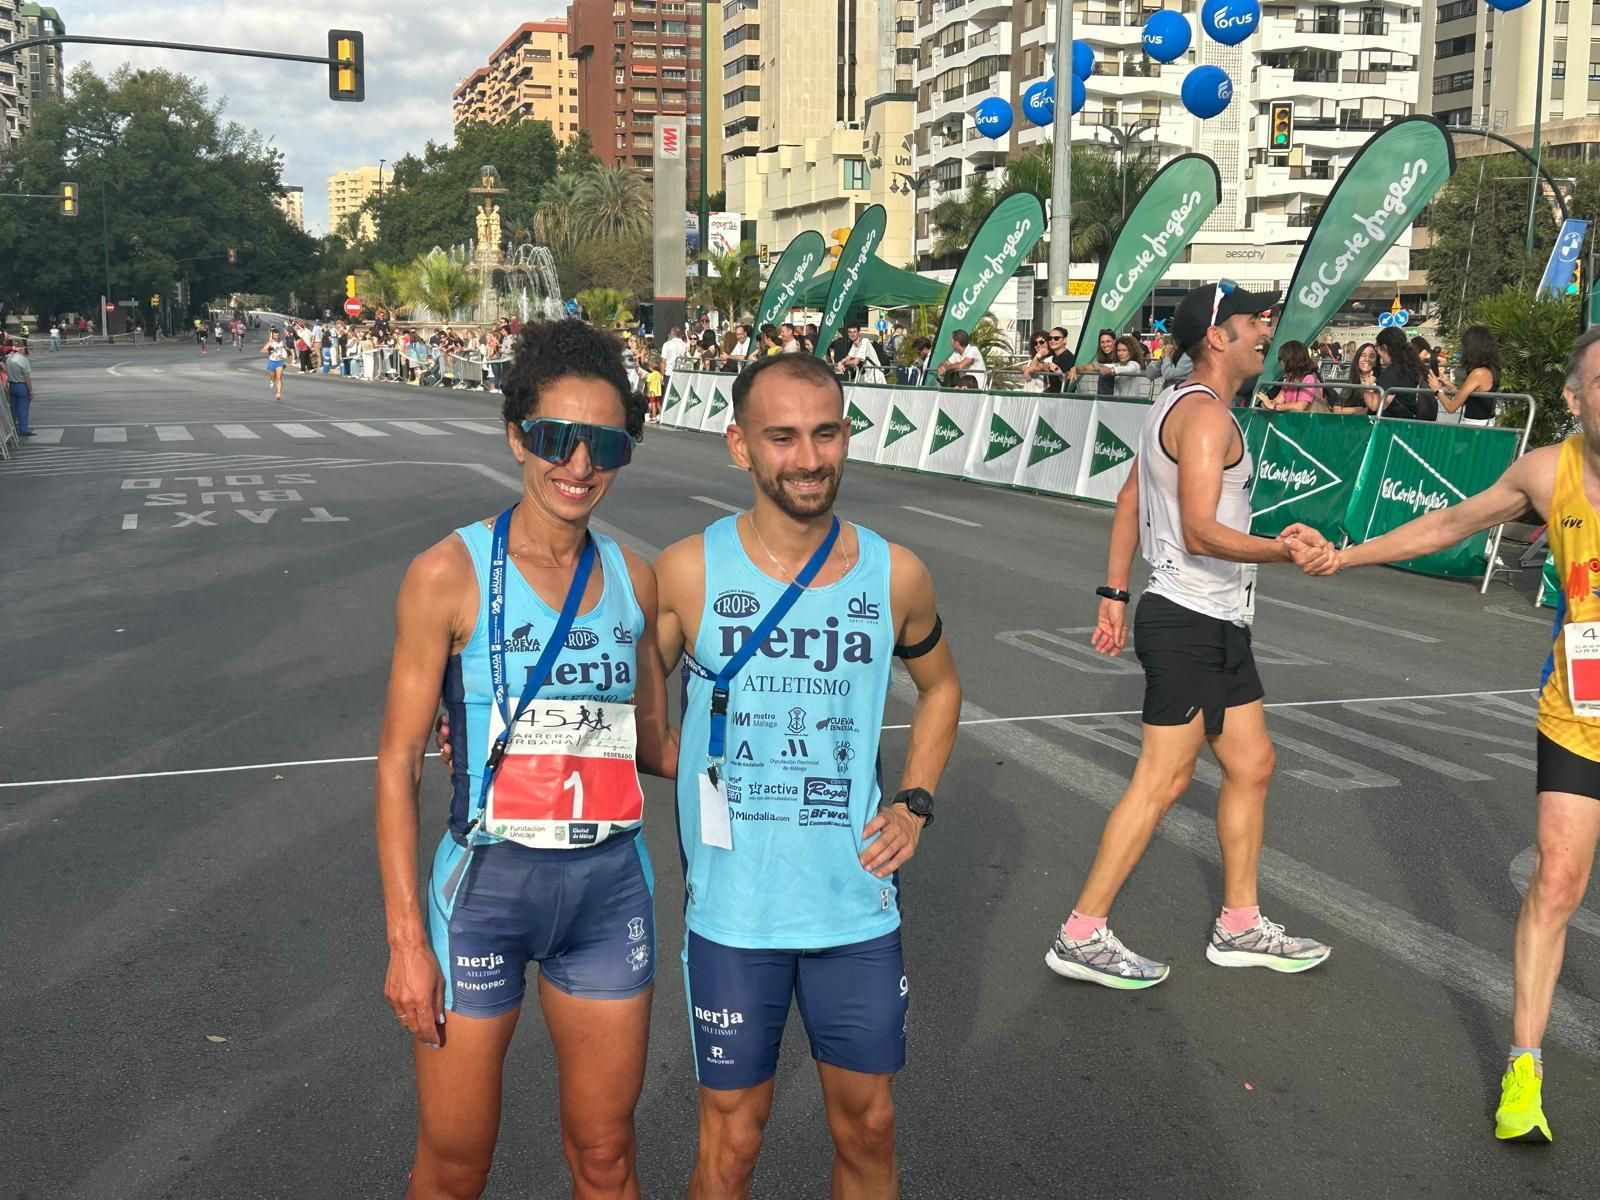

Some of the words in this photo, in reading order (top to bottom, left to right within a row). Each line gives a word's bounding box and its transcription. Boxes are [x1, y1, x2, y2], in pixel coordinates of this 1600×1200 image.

[1214, 6, 1252, 28] Forus
[1142, 24, 1163, 44] rus
[895, 156, 912, 165] Uni
[1299, 281, 1330, 309] El
[1318, 232, 1370, 286] Corte
[1352, 158, 1428, 241] Inglés
[1101, 288, 1124, 312] El
[1116, 250, 1155, 293] Corte
[1142, 190, 1201, 258] Inglés
[1225, 249, 1265, 260] aesophy
[826, 315, 836, 326] El
[832, 280, 853, 312] Corte
[847, 229, 876, 280] Inglés
[951, 302, 970, 320] El
[963, 268, 994, 305] Corte
[984, 218, 1031, 275] Inglés
[767, 292, 788, 321] Corte
[782, 252, 813, 296] Inglés
[121, 474, 317, 489] SOLO
[1260, 460, 1269, 479] El
[1268, 462, 1289, 482] Corte
[1285, 460, 1317, 490] Inglés
[144, 490, 302, 506] BUS
[1382, 477, 1394, 498] El
[1392, 480, 1416, 505] Corte
[1413, 480, 1449, 515] Inglés
[122, 506, 350, 530] TAXI
[716, 595, 757, 614] TROPS
[504, 639, 540, 647] CUEVA
[719, 616, 873, 672] nerja
[742, 675, 850, 697] ATLETISMO
[518, 709, 568, 728] 45
[830, 717, 854, 725] CUEVA
[603, 751, 632, 759] FEDERADO
[564, 770, 584, 818] 1
[764, 783, 798, 795] activa
[456, 952, 504, 970] nerja
[457, 979, 505, 991] RUNOPRO
[694, 1006, 744, 1028] nerja
